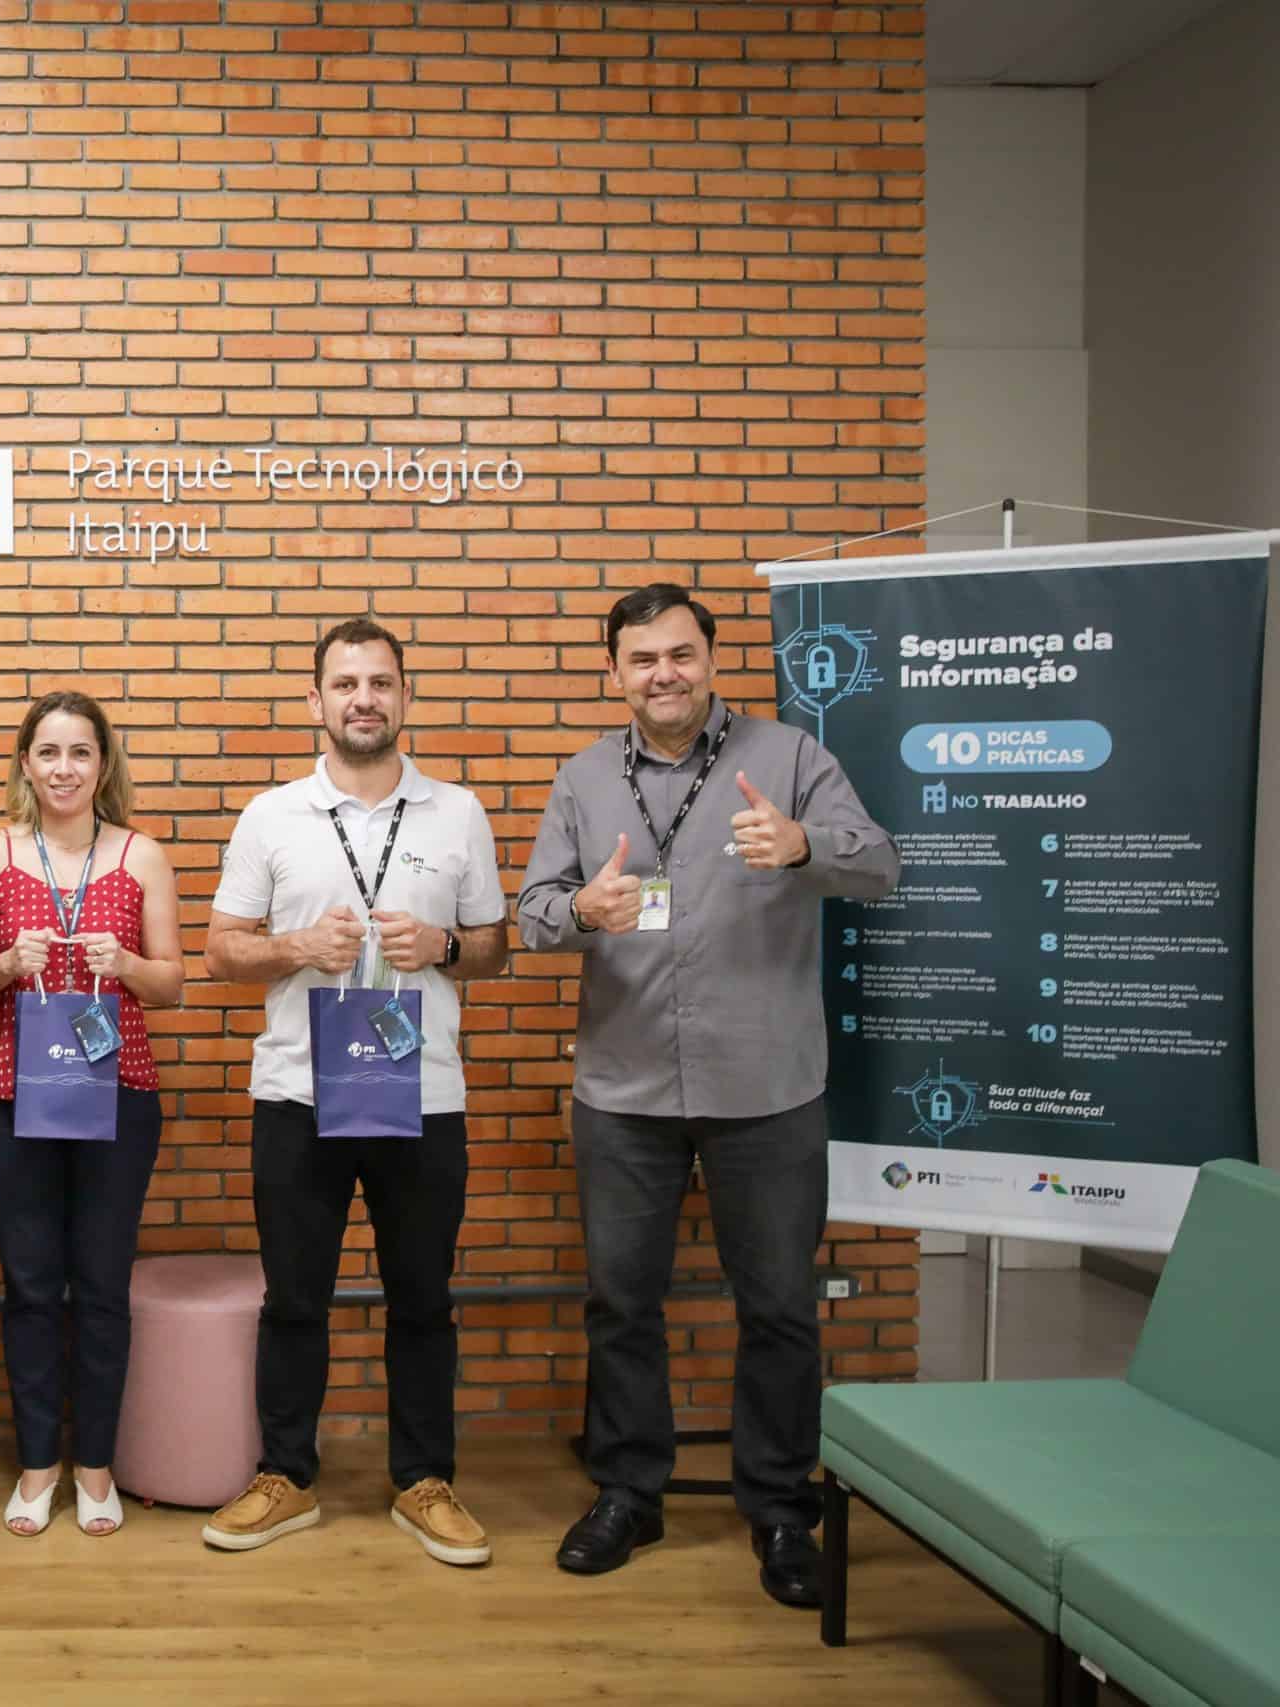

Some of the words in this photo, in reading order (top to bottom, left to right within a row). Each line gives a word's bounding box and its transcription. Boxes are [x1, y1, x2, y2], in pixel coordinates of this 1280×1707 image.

[69, 449, 233, 503] Parque
[244, 447, 523, 503] Tecnológico
[69, 511, 210, 565] Itaipu
[900, 634, 1063, 661] Segurança
[1073, 628, 1112, 650] da
[901, 660, 1077, 689] Informação
[988, 731, 1047, 745] DICAS
[926, 732, 980, 764] 10
[988, 747, 1084, 764] PRÁTICAS
[953, 795, 978, 808] NO
[983, 795, 1086, 808] TRABALHO
[1041, 834, 1058, 852] 6
[1042, 880, 1058, 897] 7
[843, 928, 857, 945] 3
[1041, 933, 1057, 951] 8
[842, 964, 857, 981] 4
[1040, 978, 1057, 996] 9
[843, 1016, 856, 1032] 5
[1027, 1024, 1056, 1043] 10
[989, 1085, 1015, 1096] Sua
[1018, 1088, 1066, 1099] atitude
[1070, 1089, 1091, 1101] faz
[989, 1099, 1019, 1110] toda
[1023, 1103, 1032, 1111] a
[1035, 1102, 1104, 1118] diferença!
[918, 1172, 940, 1184] PTI
[1071, 1185, 1125, 1199] ITAIPU
